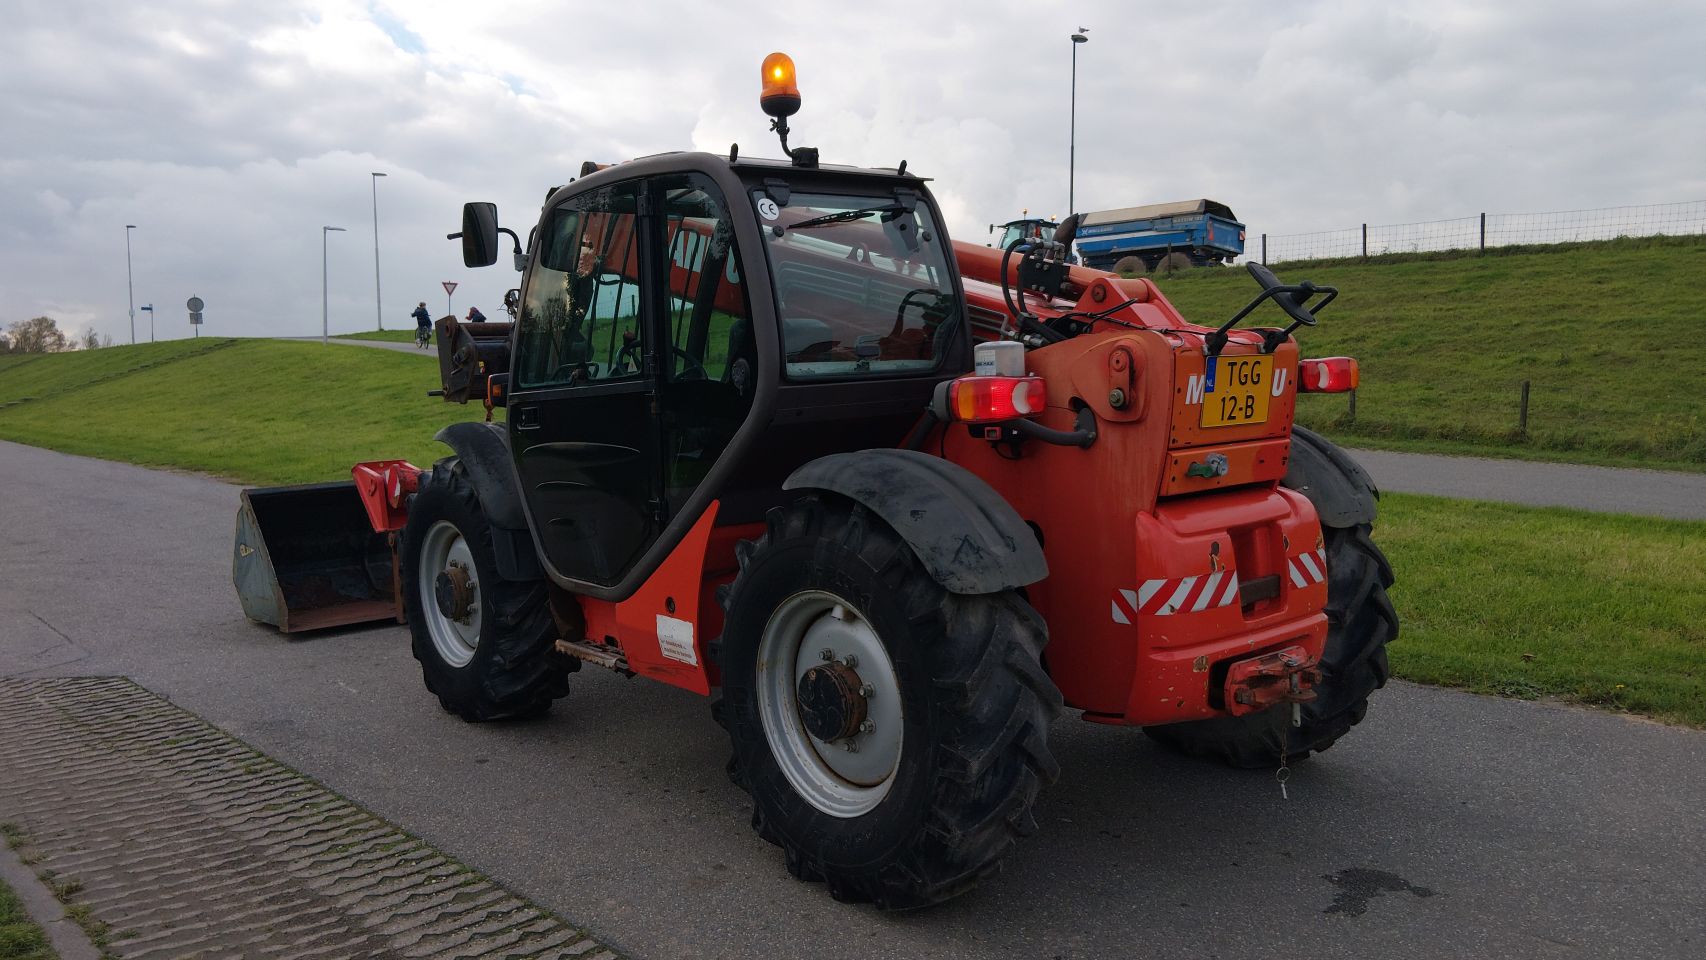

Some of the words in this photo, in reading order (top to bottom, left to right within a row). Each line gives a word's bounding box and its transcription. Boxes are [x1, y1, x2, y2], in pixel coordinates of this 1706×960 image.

[1206, 379, 1213, 387] NL
[1227, 360, 1260, 386] TGG
[1220, 395, 1255, 420] 12-B
